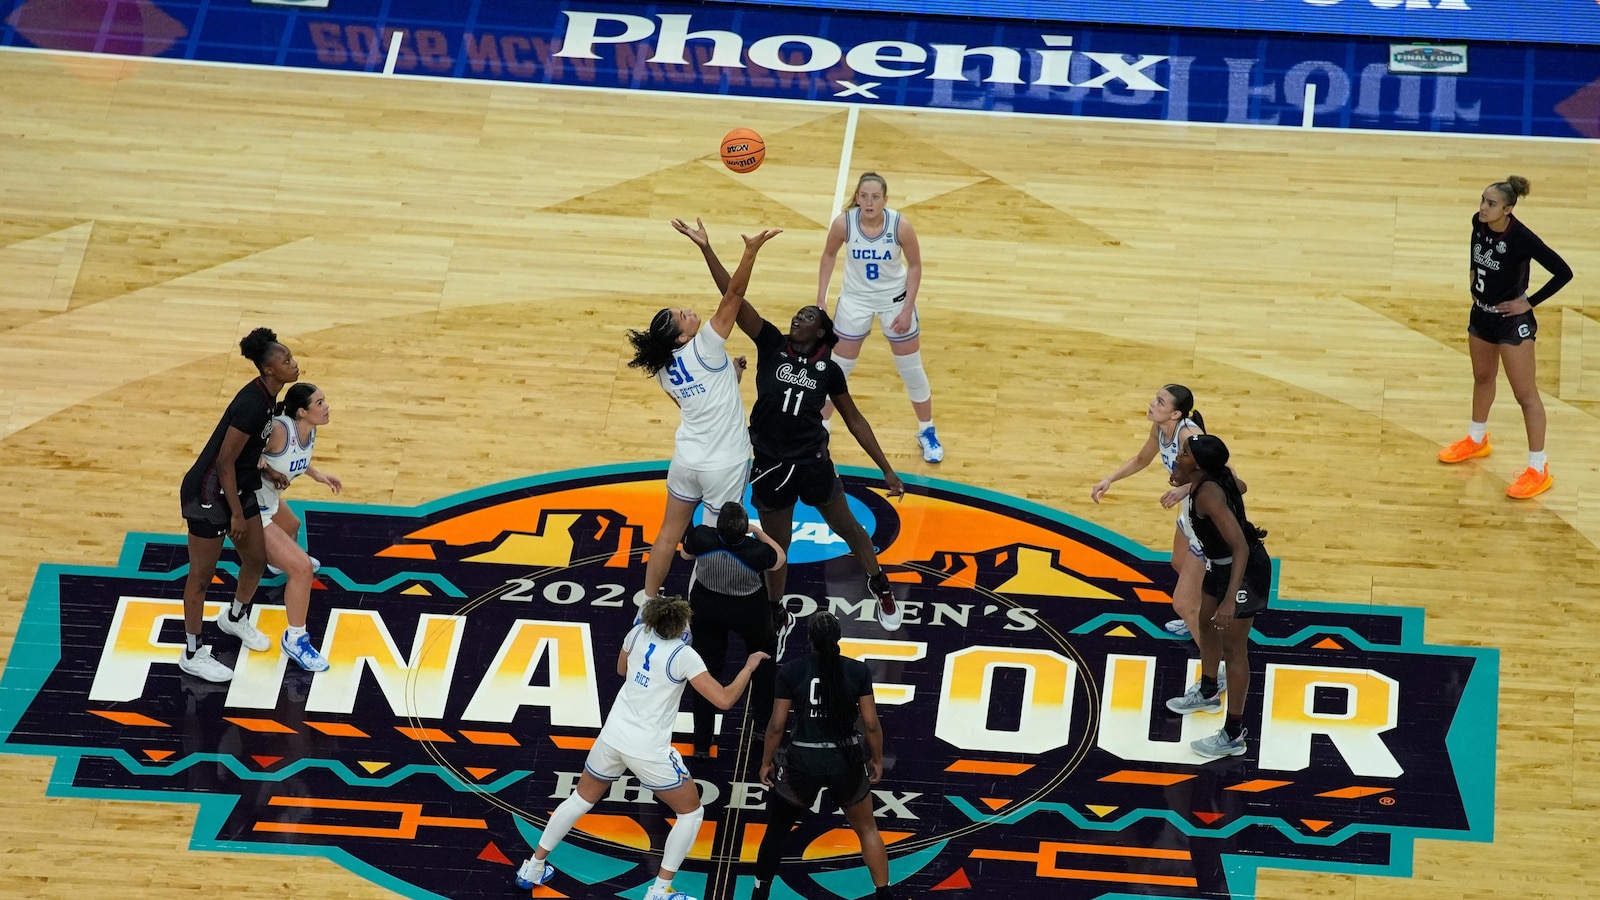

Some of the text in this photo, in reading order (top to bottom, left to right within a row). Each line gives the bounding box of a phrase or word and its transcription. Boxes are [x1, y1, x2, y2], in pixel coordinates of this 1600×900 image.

[551, 10, 1170, 91] Phoenix
[1431, 54, 1460, 62] FOUR
[727, 144, 749, 153] NCAA
[726, 156, 756, 167] Wilson
[852, 249, 892, 260] UCLA
[865, 263, 879, 280] 8
[1475, 267, 1486, 293] 5
[665, 356, 695, 386] 51
[775, 362, 817, 390] Carolina
[680, 383, 706, 399] BETTS
[782, 387, 804, 417] 11
[779, 594, 1039, 632] OMEN'S
[642, 643, 657, 672] 1
[634, 671, 651, 688] RICE
